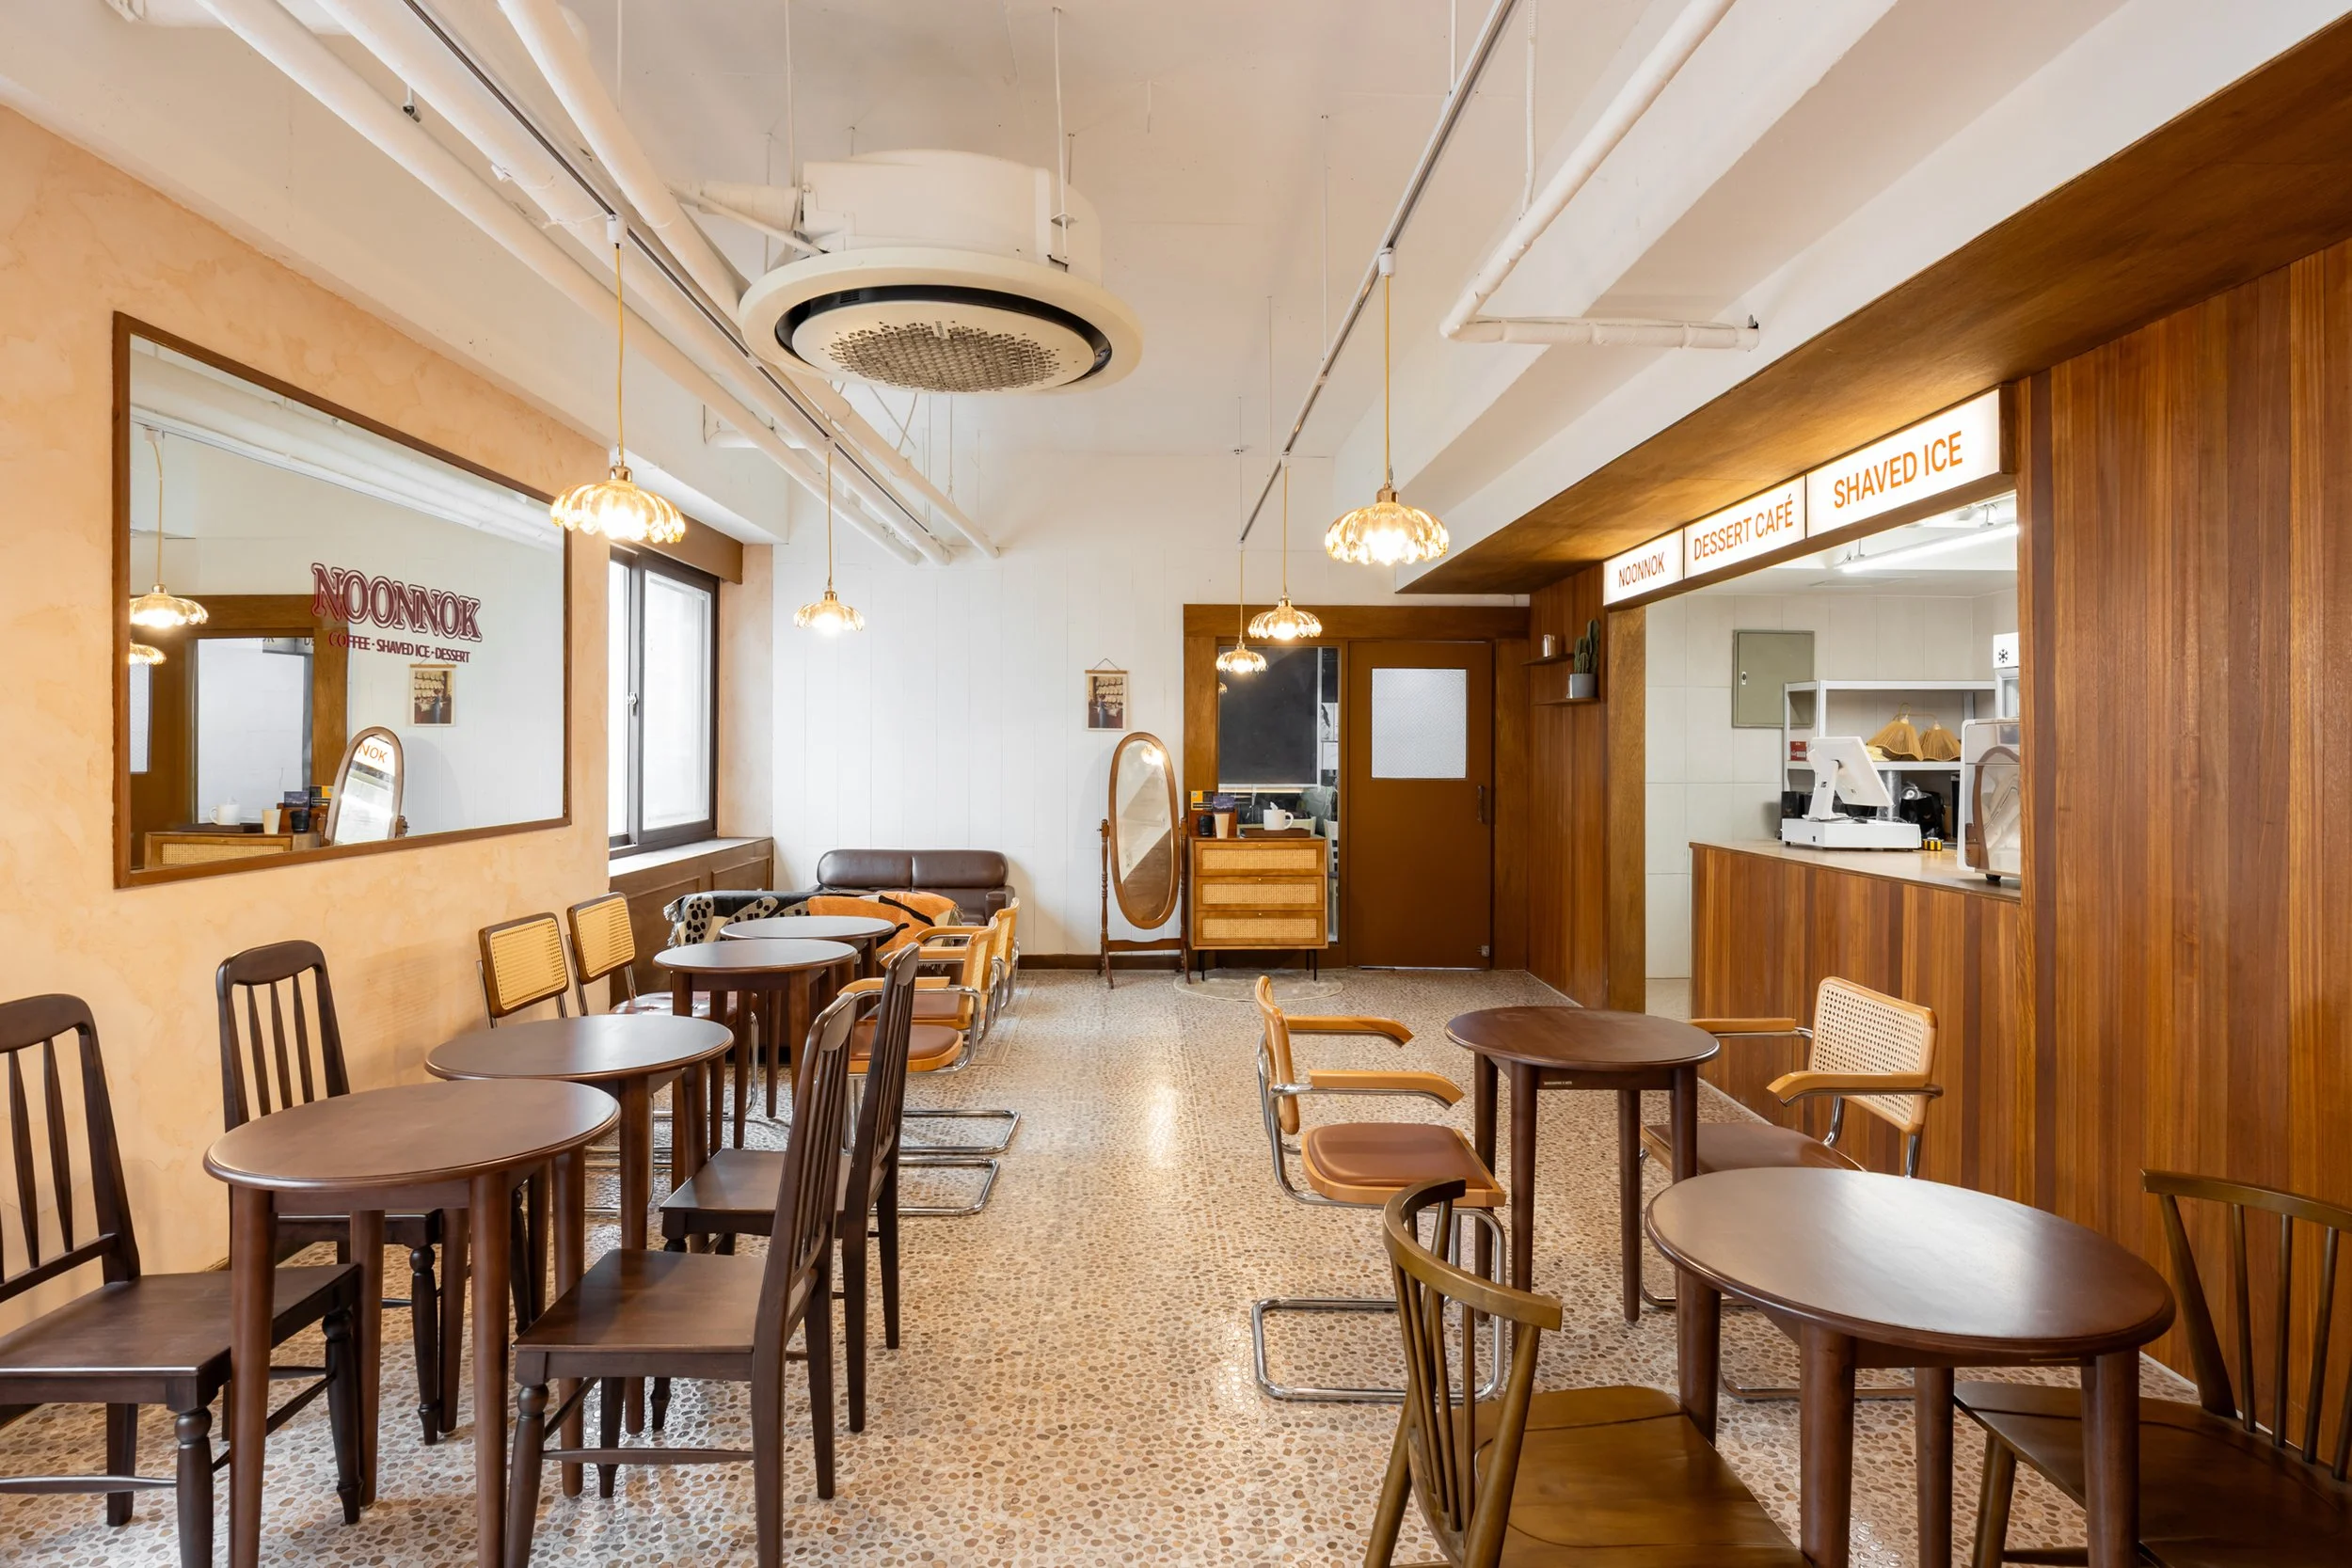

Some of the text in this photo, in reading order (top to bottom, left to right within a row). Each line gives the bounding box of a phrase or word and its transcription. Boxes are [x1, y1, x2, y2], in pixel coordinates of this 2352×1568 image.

[1834, 430, 1963, 509] SHAVED ICE
[1693, 493, 1793, 562] DESSERT CAFÉ
[311, 562, 482, 642] NOONNOK
[1618, 551, 1665, 588] NOONNOK
[329, 632, 371, 651] COFFEE
[376, 639, 414, 657] SHAVED
[415, 644, 430, 658] ICE
[435, 647, 470, 663] DESSERT
